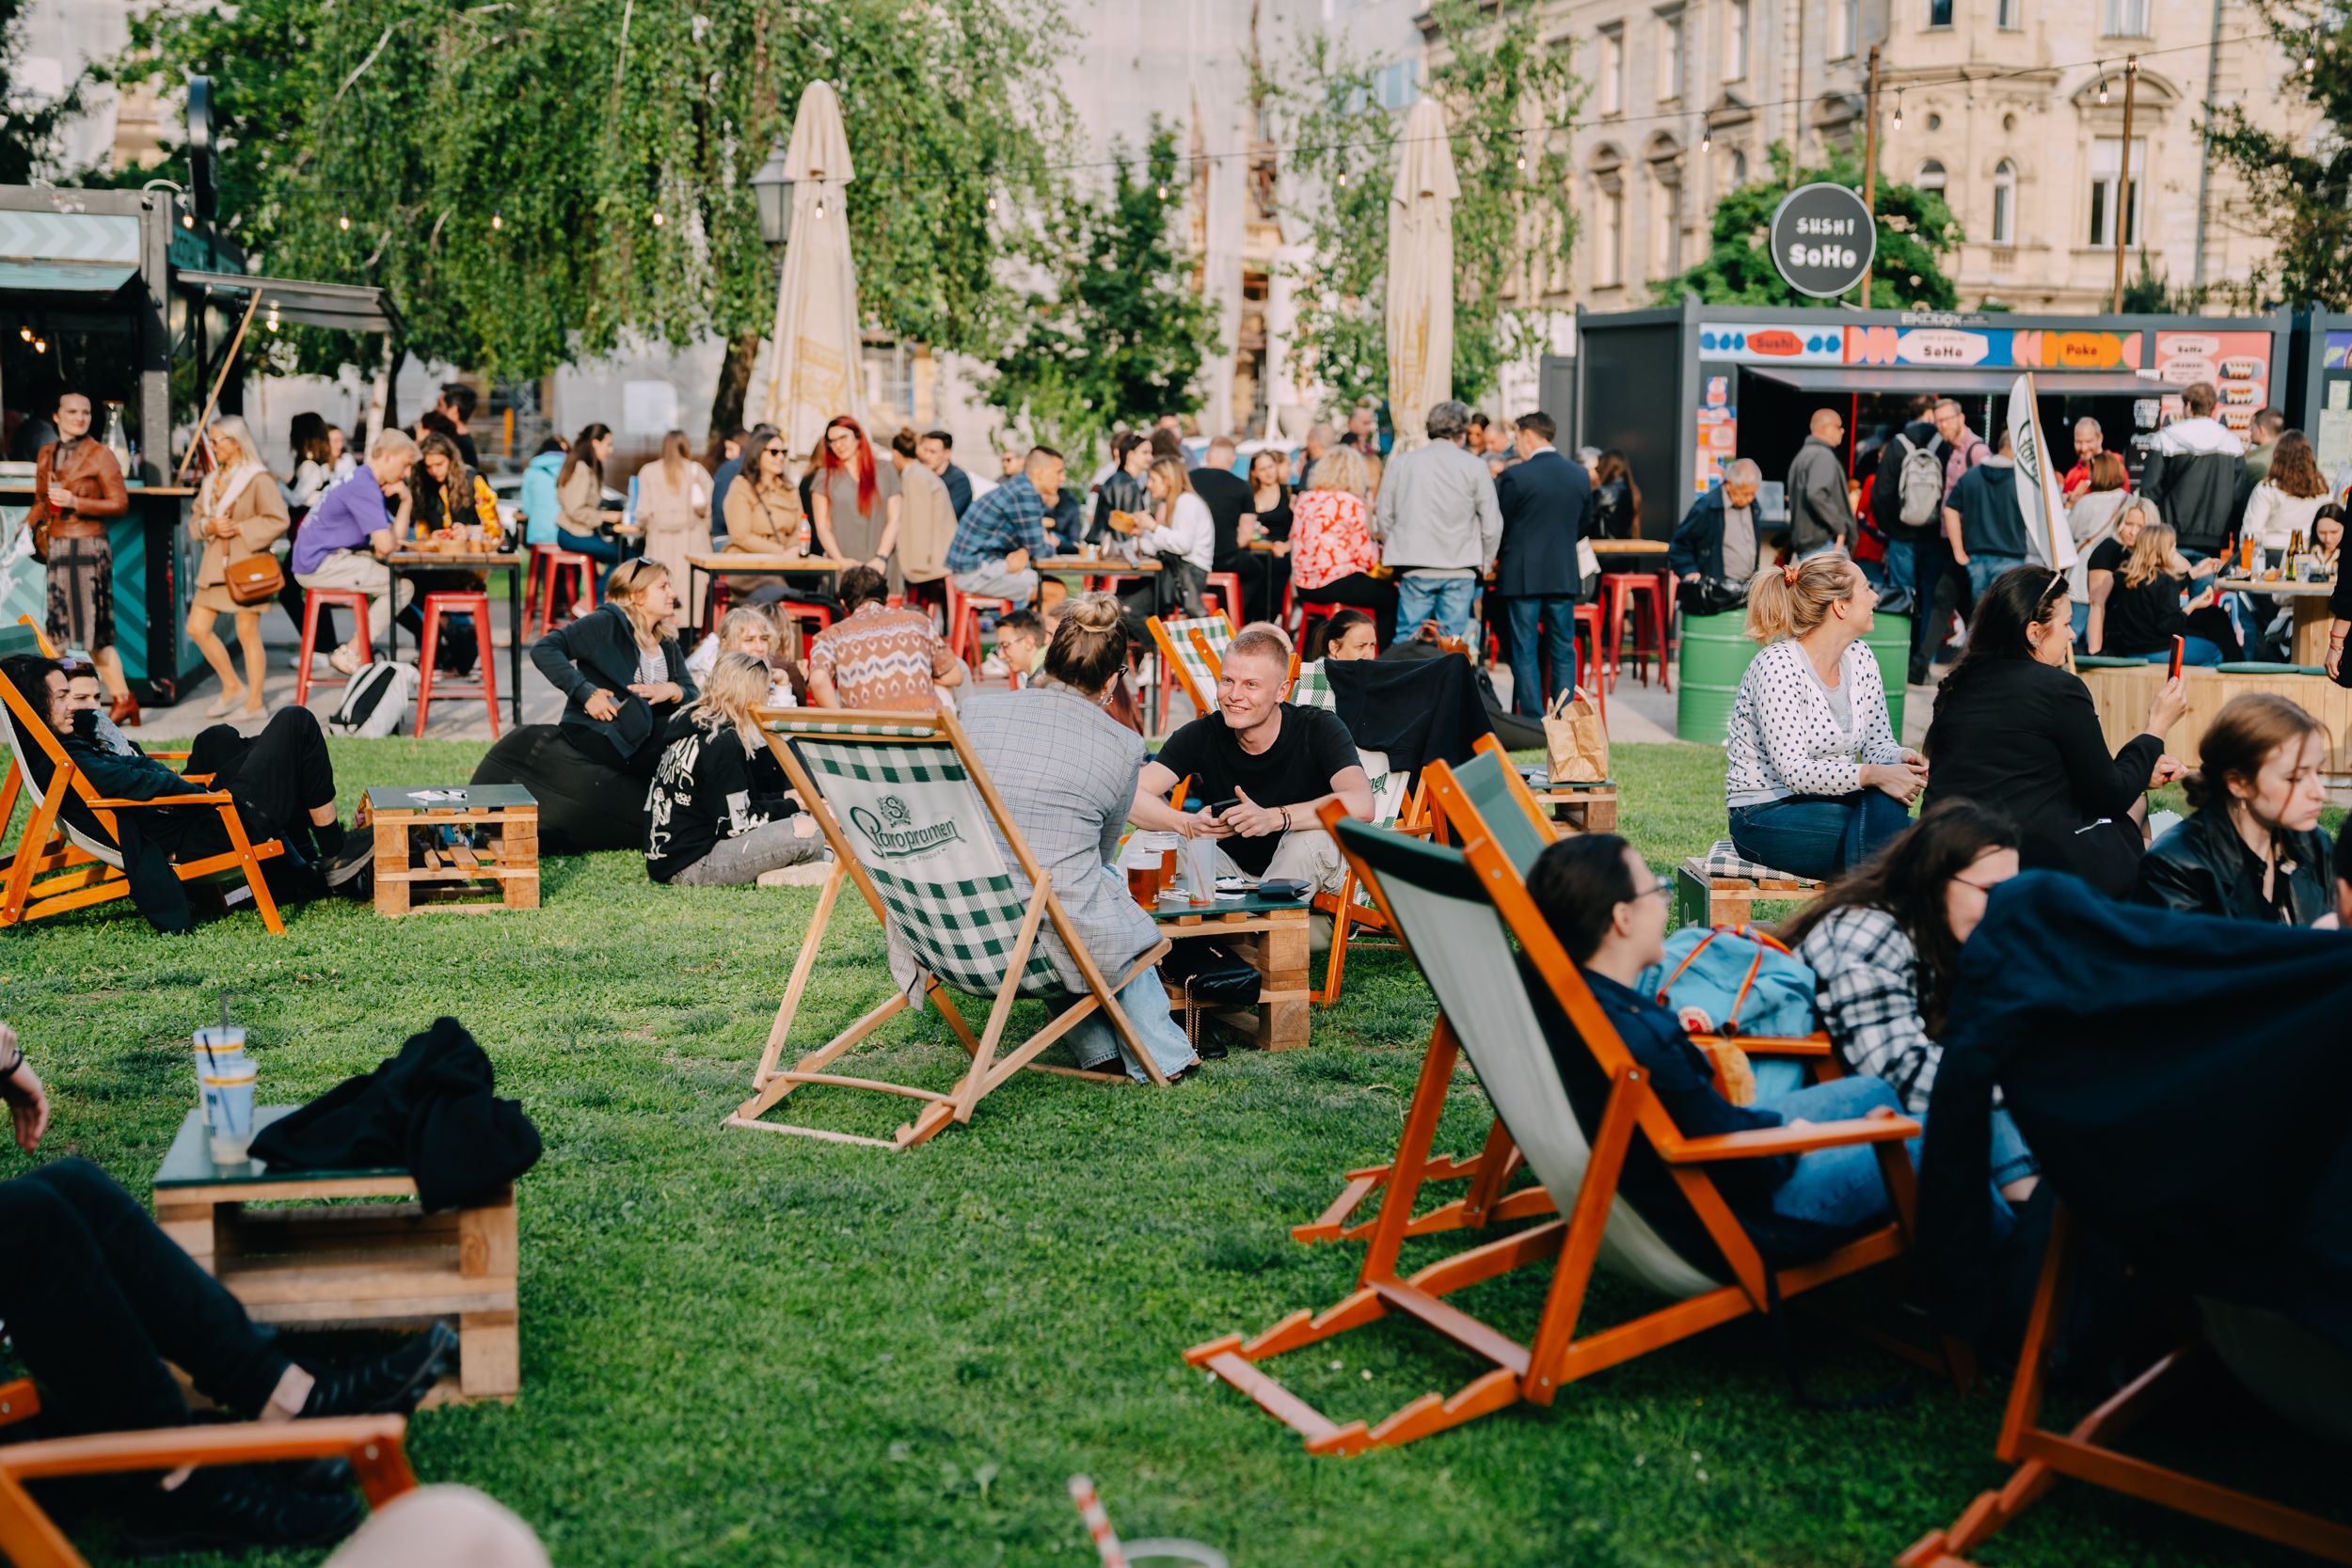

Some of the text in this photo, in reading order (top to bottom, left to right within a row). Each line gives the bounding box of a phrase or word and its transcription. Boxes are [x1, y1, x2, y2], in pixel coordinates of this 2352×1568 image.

[1796, 217, 1855, 235] SUSHI
[1789, 244, 1857, 268] SoHo
[1756, 337, 1794, 348] Sushi
[2065, 343, 2099, 357] Poke
[1924, 345, 1963, 357] SoHo
[850, 806, 965, 860] Staropramen
